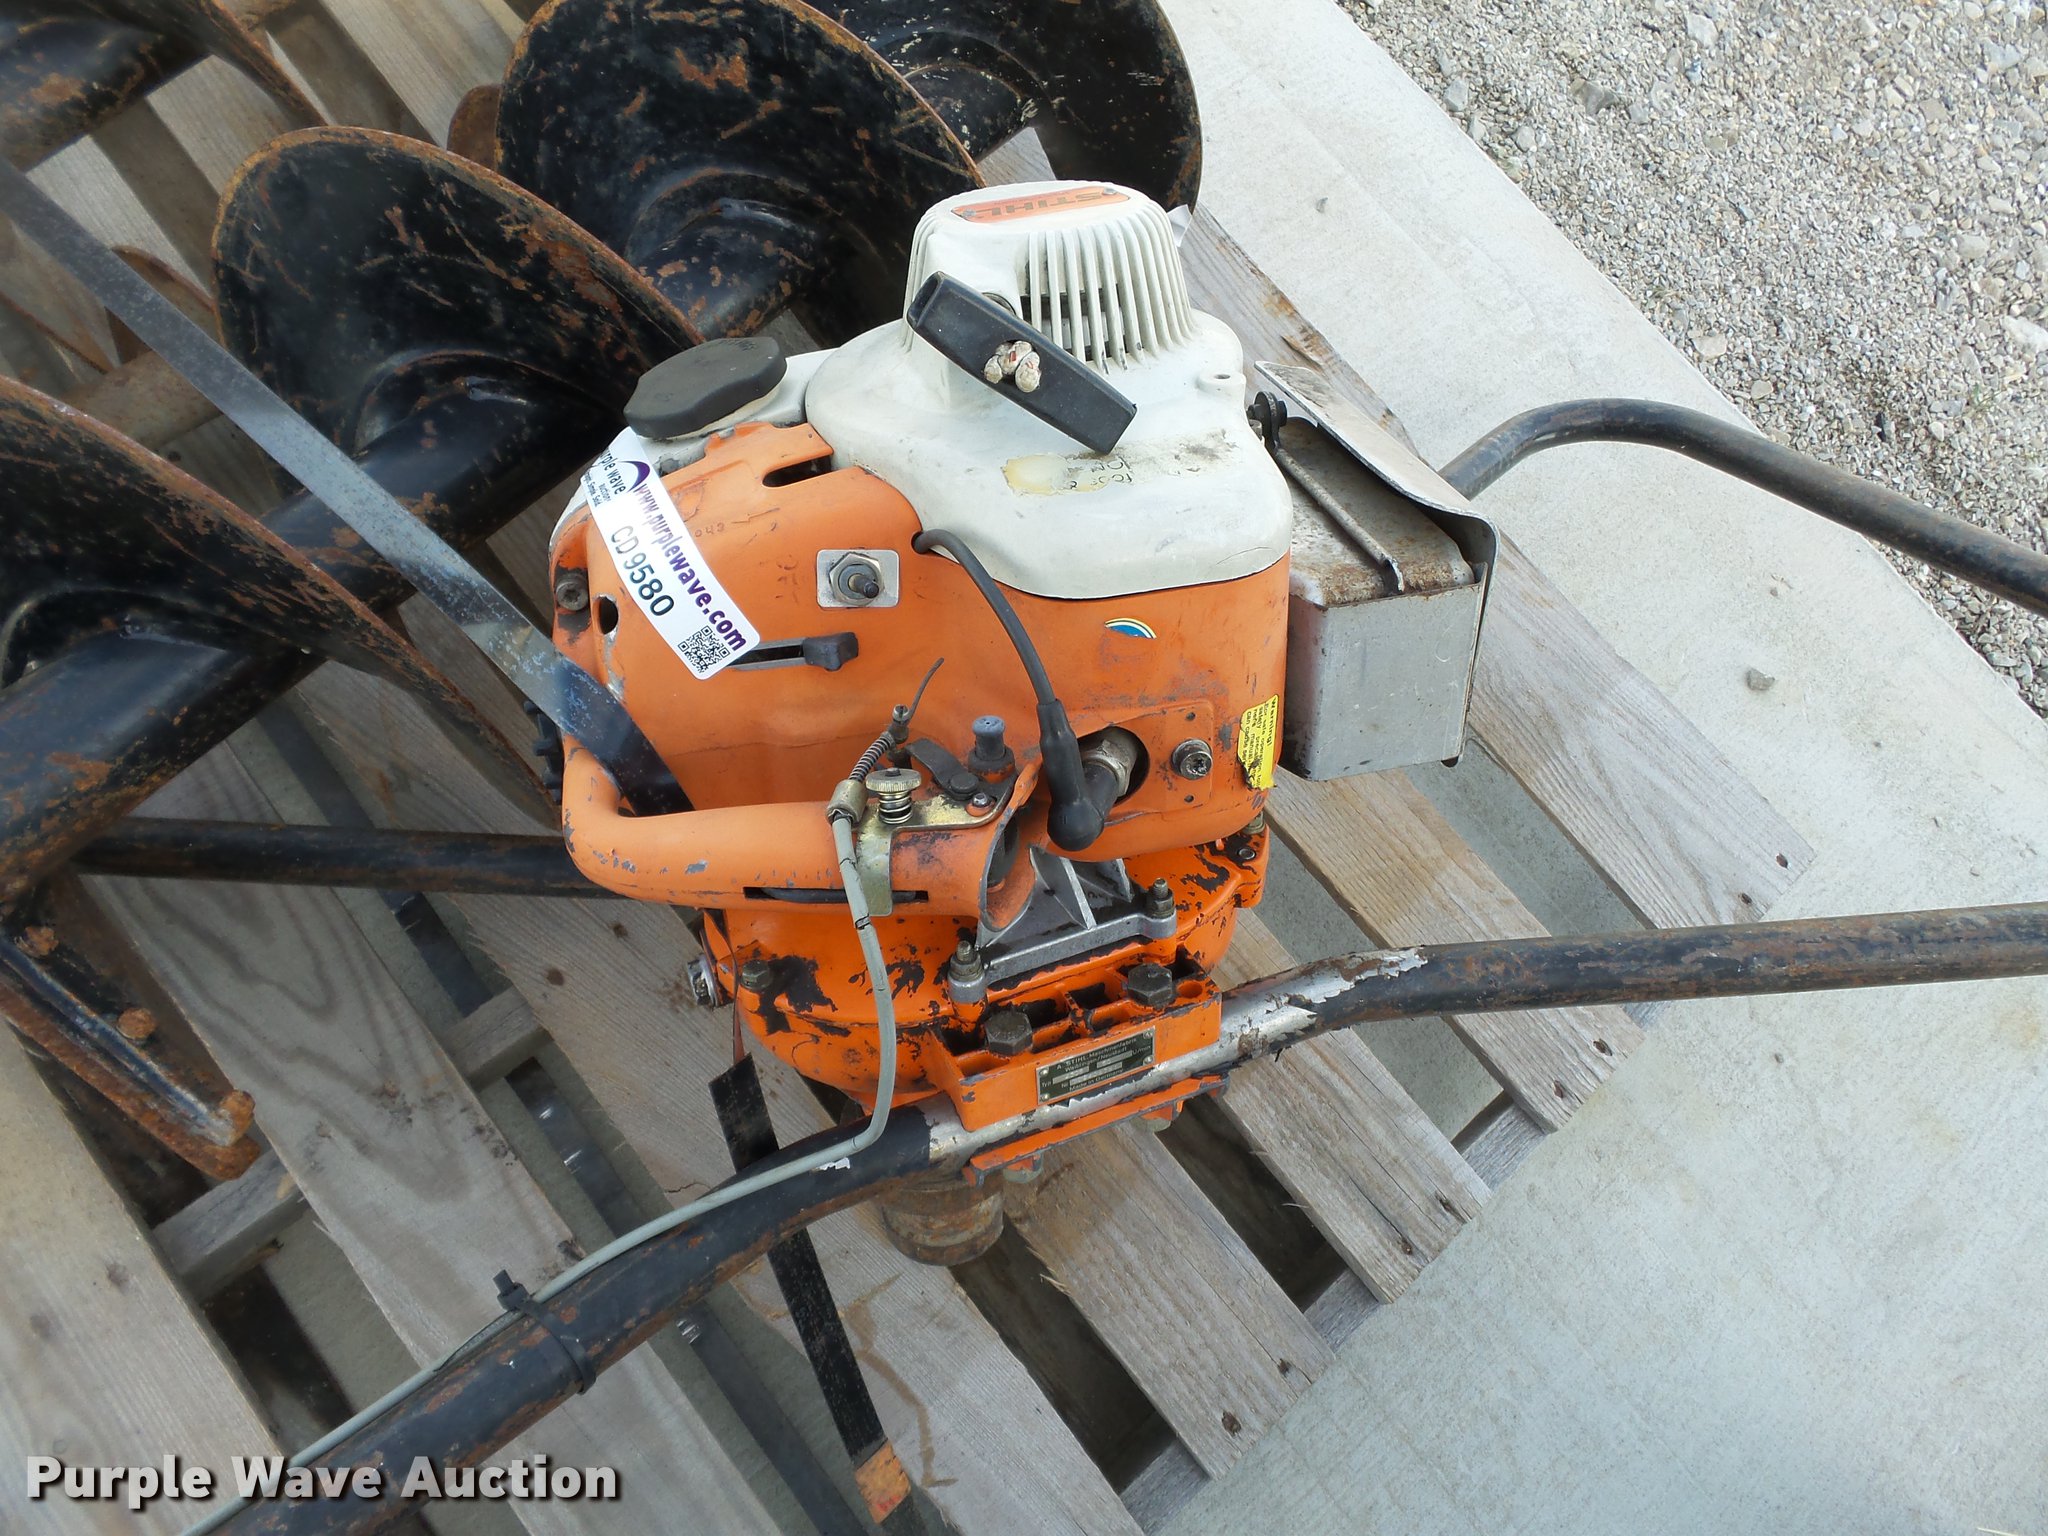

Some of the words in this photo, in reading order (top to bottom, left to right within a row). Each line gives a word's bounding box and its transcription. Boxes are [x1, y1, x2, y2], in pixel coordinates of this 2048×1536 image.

[975, 191, 1101, 216] STIHL
[607, 468, 627, 495] wave
[611, 525, 674, 616] CD9580
[633, 483, 747, 651] www.purplewave.com
[1267, 698, 1277, 746] Warning!
